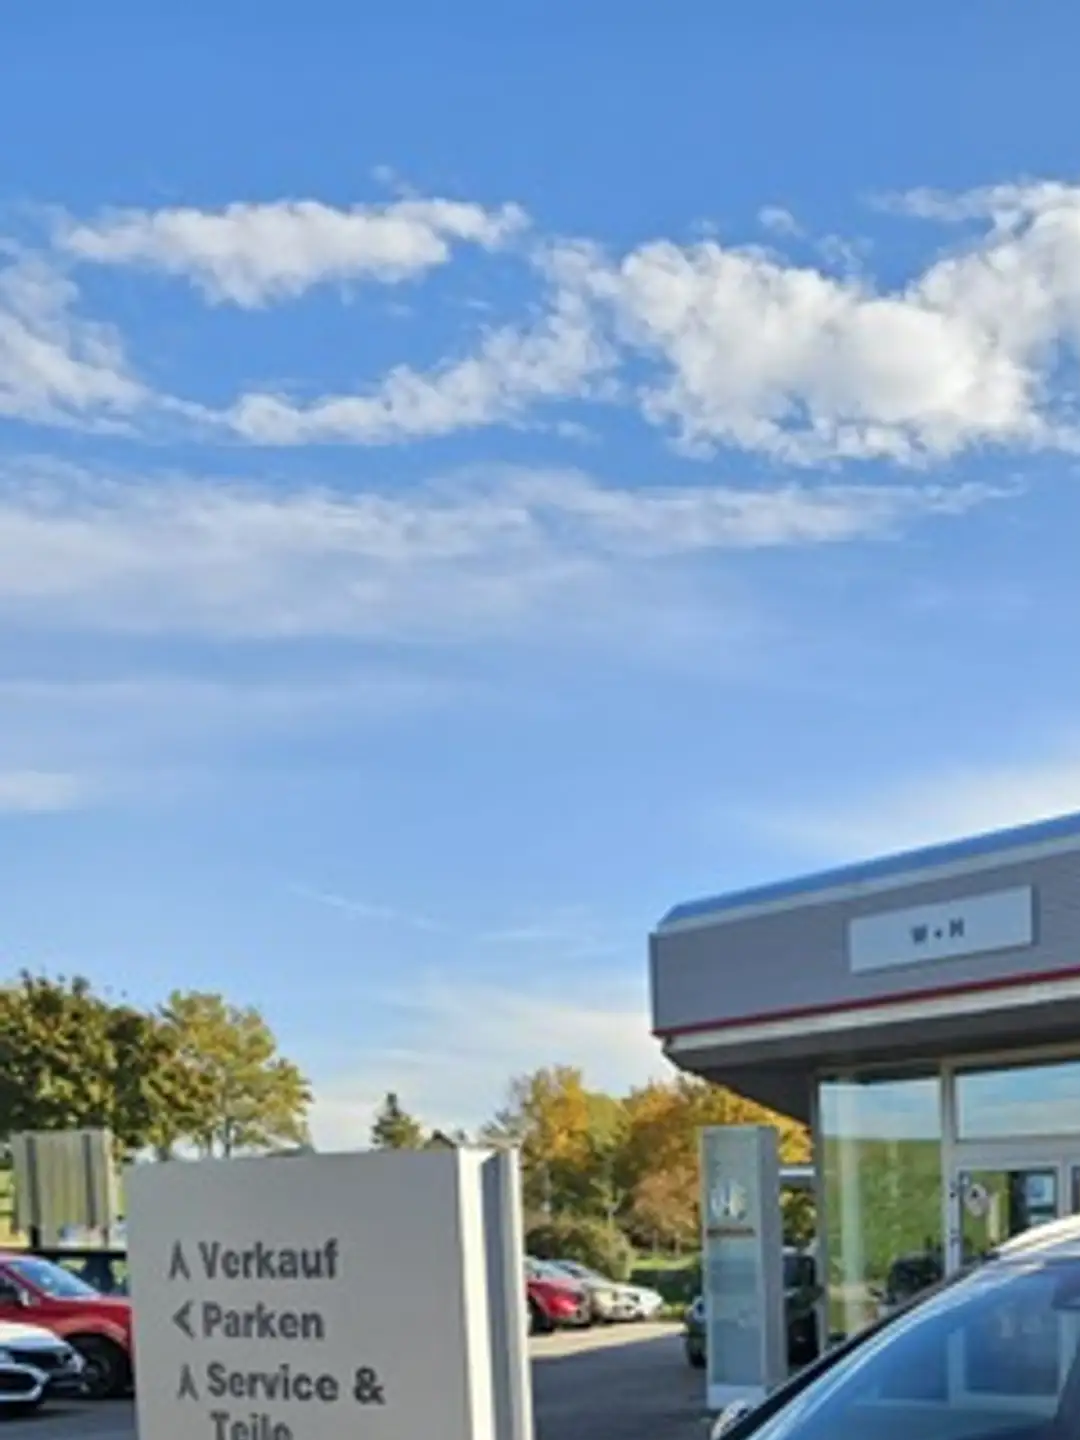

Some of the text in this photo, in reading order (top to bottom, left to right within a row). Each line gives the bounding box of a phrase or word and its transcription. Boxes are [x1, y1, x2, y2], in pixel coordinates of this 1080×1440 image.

[198, 1239, 339, 1280] Verkauf
[203, 1302, 324, 1339] Parken
[206, 1362, 386, 1405] Service &
